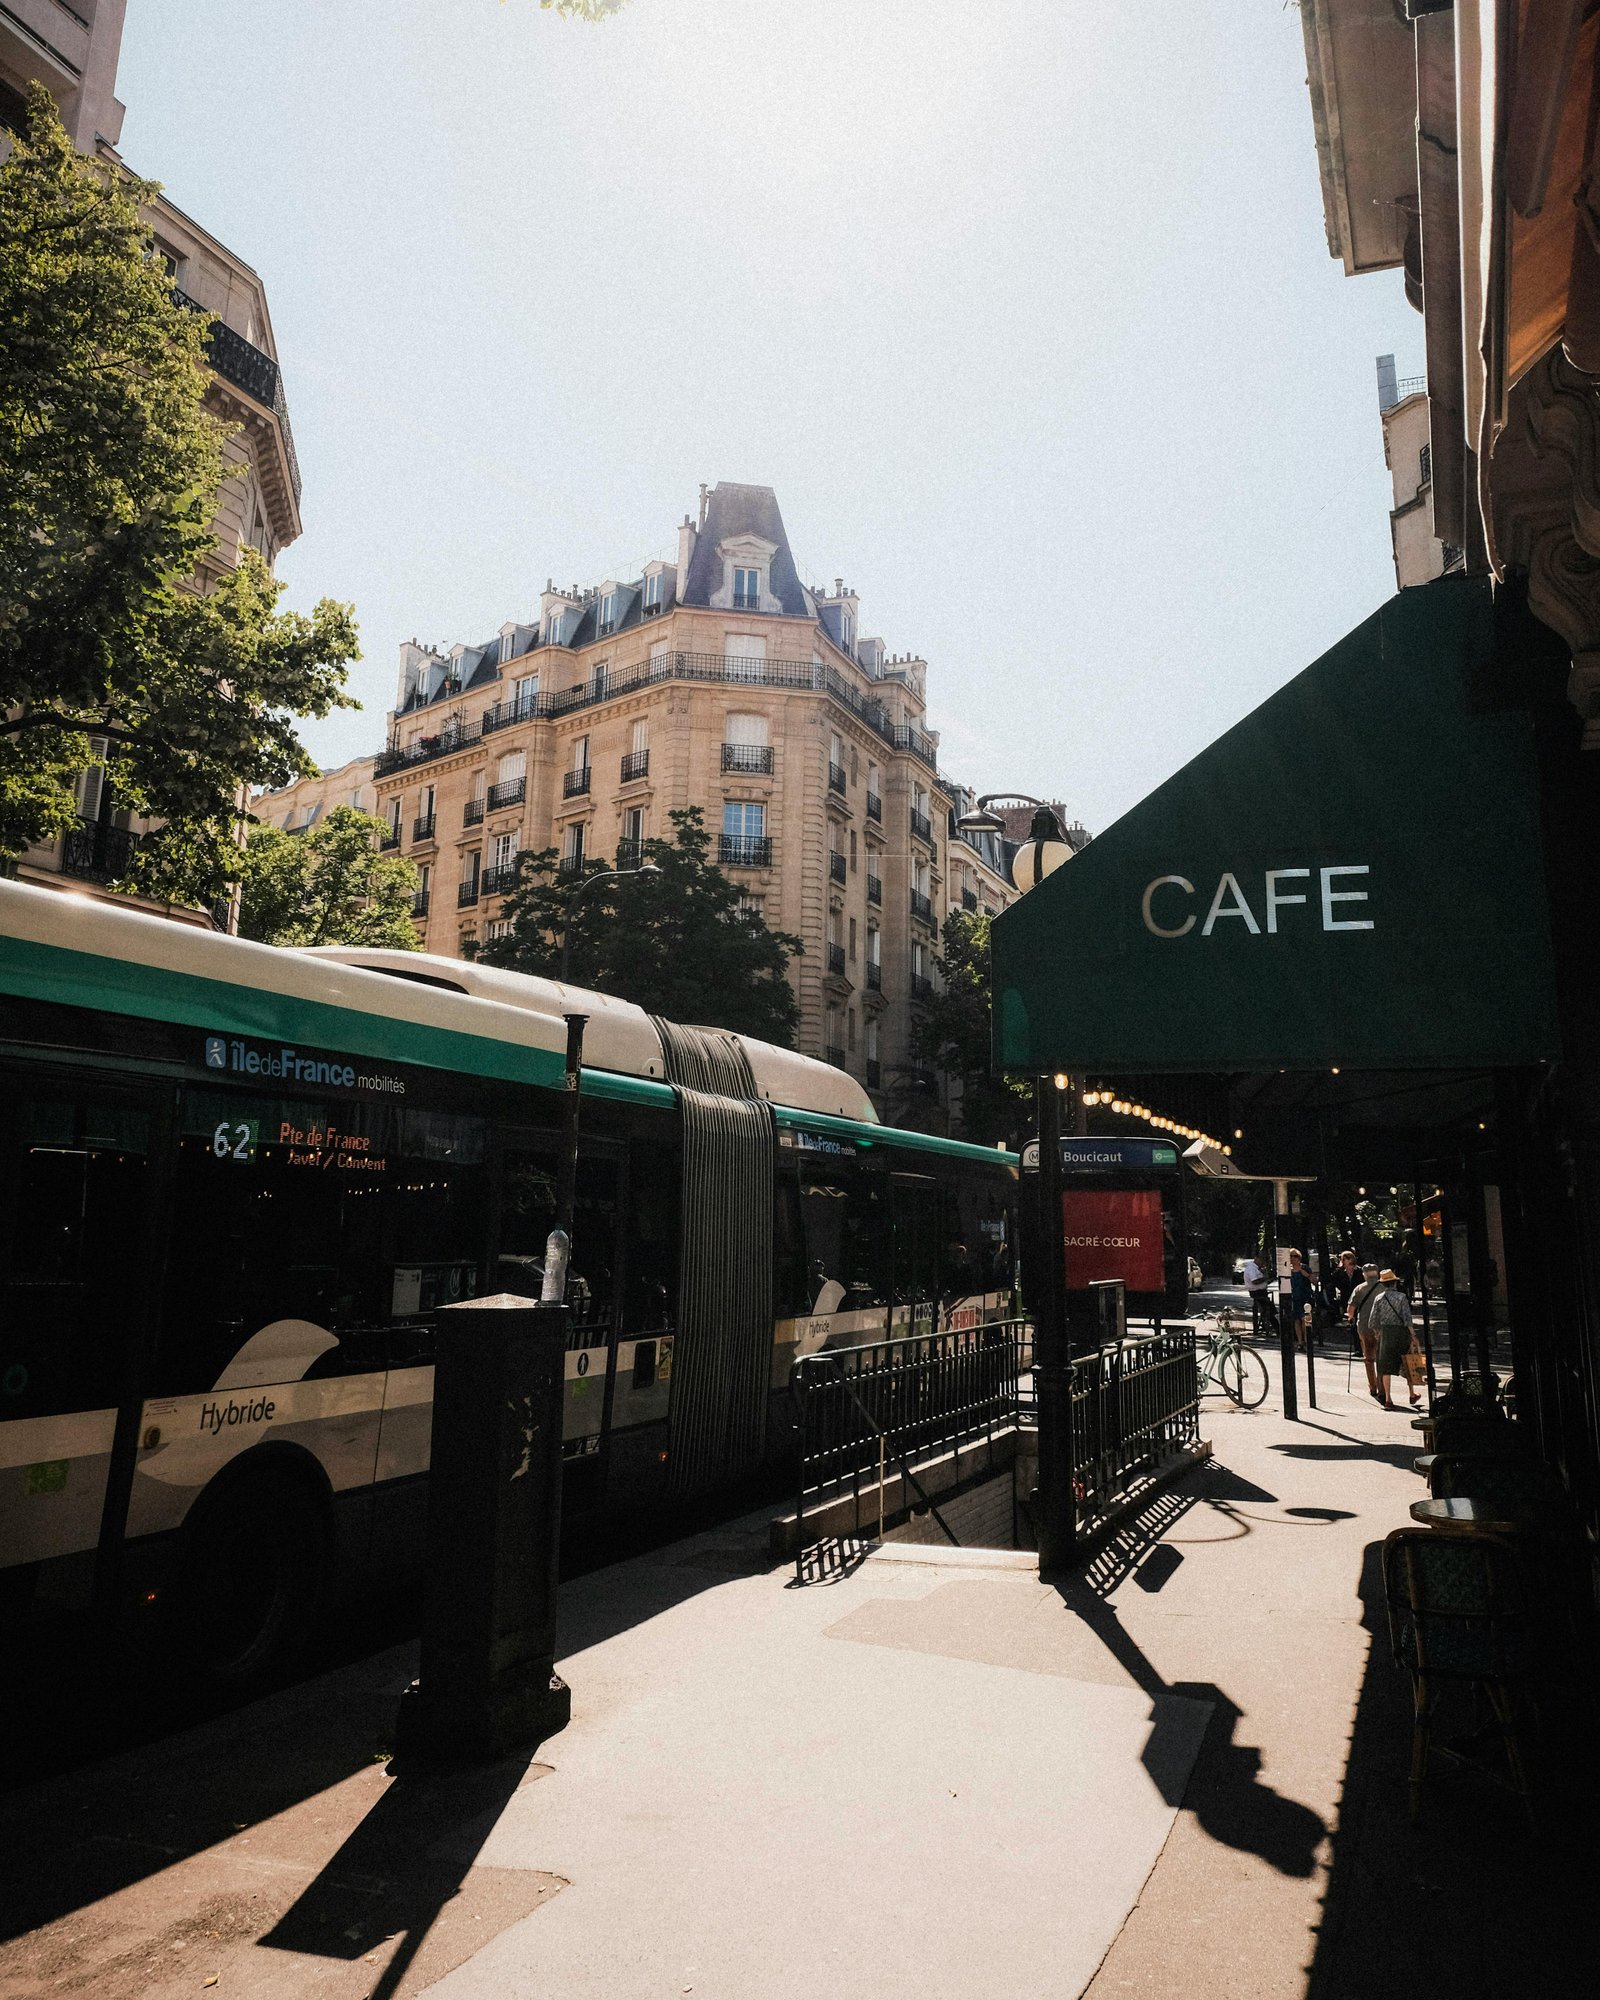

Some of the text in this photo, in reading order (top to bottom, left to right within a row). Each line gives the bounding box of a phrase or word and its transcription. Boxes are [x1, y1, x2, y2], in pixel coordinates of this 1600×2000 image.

[1141, 865, 1375, 938] CAFE
[358, 1074, 405, 1094] mobilités
[213, 1122, 250, 1160] 62
[279, 1122, 304, 1145] Pte
[307, 1126, 323, 1147] de
[326, 1127, 370, 1151] France
[337, 1153, 386, 1171] Convent
[1063, 1151, 1122, 1163] Boucicaut
[1063, 1236, 1141, 1247] SACRÉ-CŒUR
[808, 1320, 830, 1338] Hybride
[200, 1395, 275, 1436] Hybride
